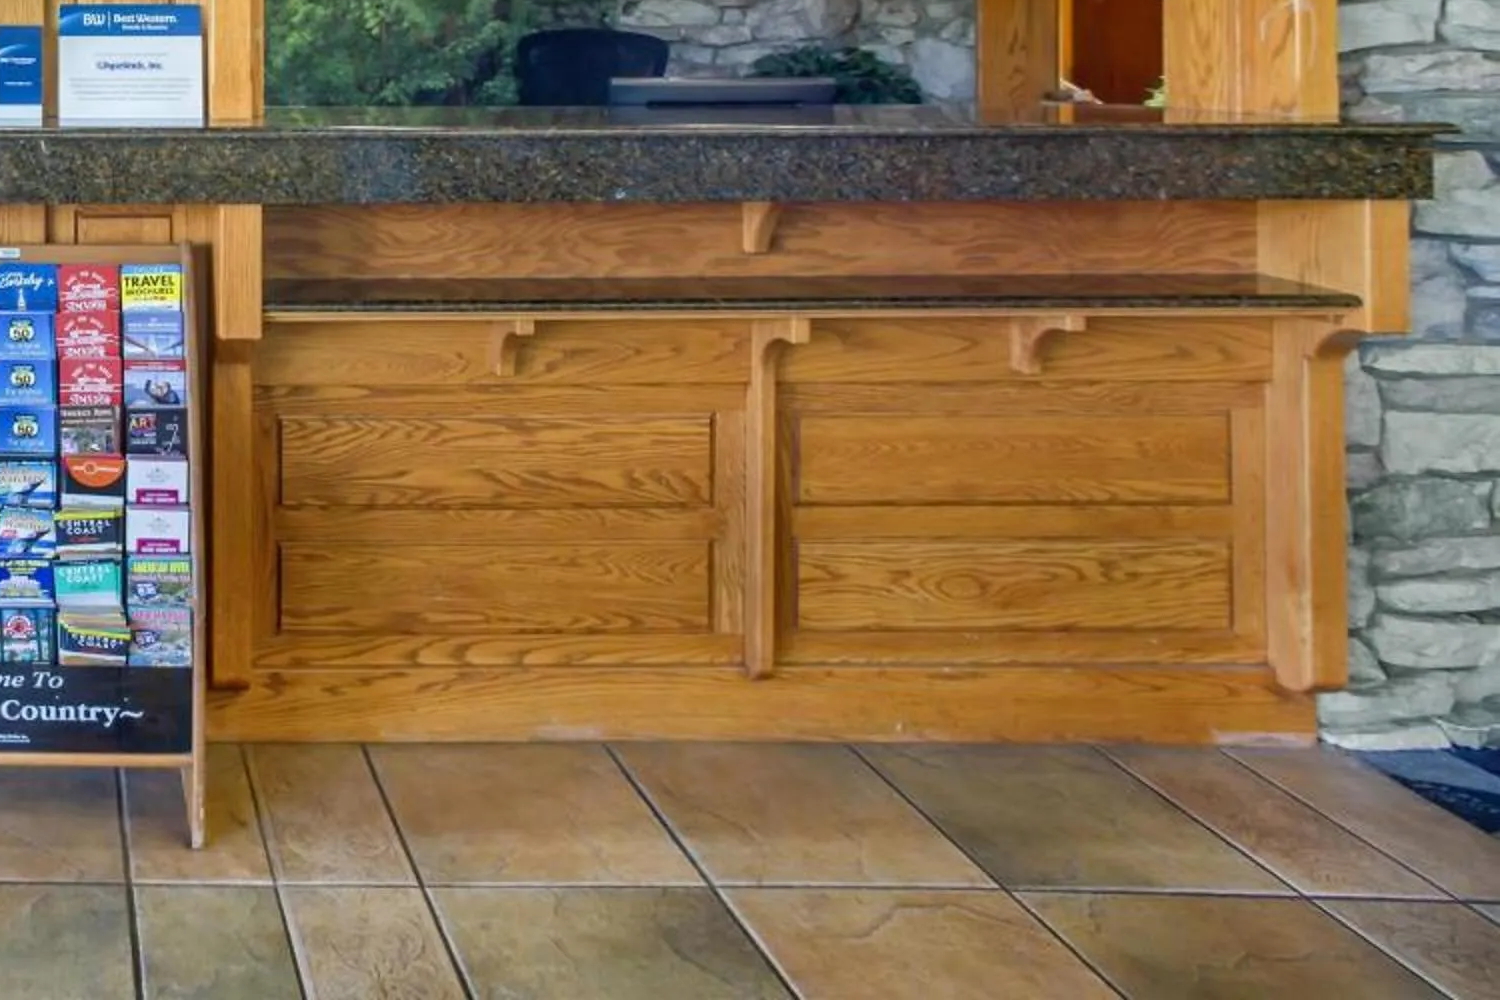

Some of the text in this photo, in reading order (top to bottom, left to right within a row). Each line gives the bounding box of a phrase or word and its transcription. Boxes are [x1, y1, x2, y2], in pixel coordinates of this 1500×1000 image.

[124, 274, 175, 287] TRAVEL
[66, 527, 104, 536] COAST
[66, 574, 104, 583] COAST
[32, 671, 64, 689] To
